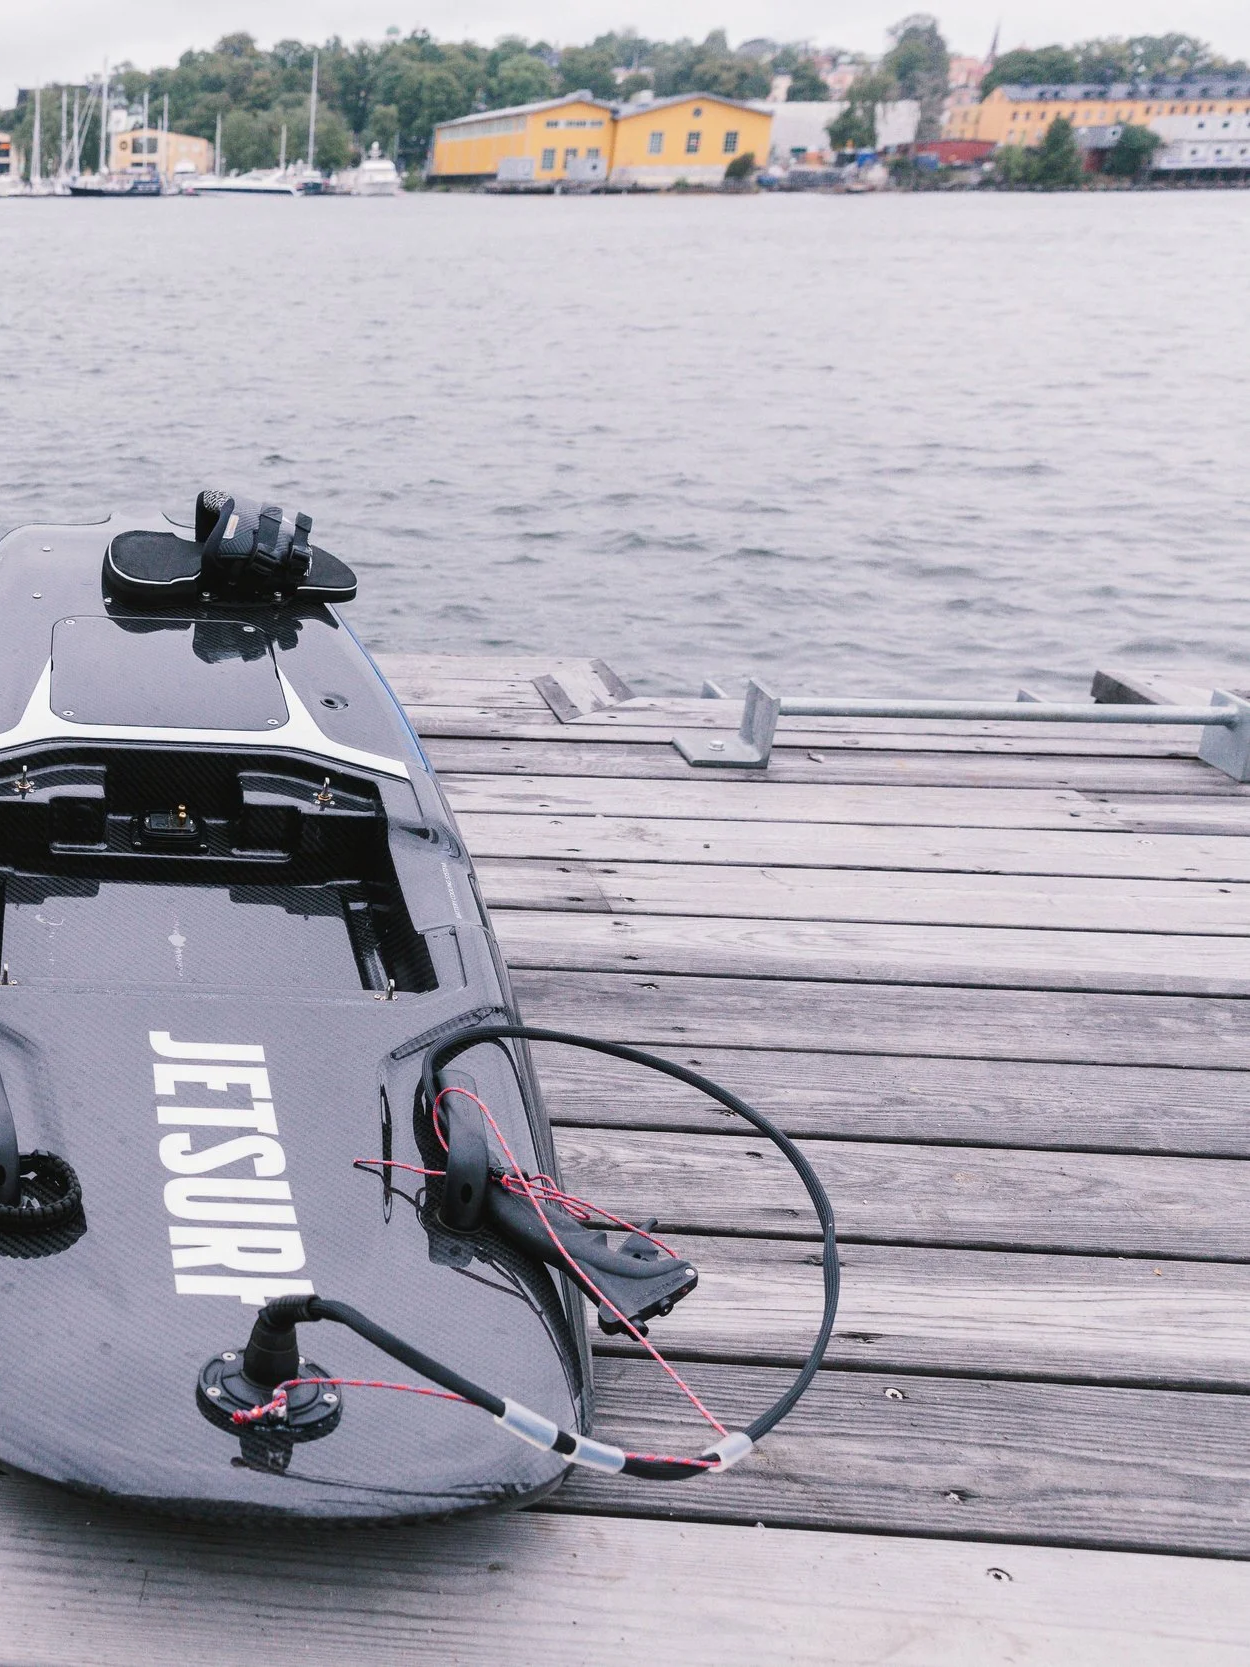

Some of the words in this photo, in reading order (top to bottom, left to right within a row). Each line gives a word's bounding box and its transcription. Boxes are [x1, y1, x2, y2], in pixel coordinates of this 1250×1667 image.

[440, 862, 450, 880] SYSTEM
[445, 880, 456, 900] COOLING
[452, 900, 462, 919] BATTERY
[149, 1030, 315, 1306] JETSURF
